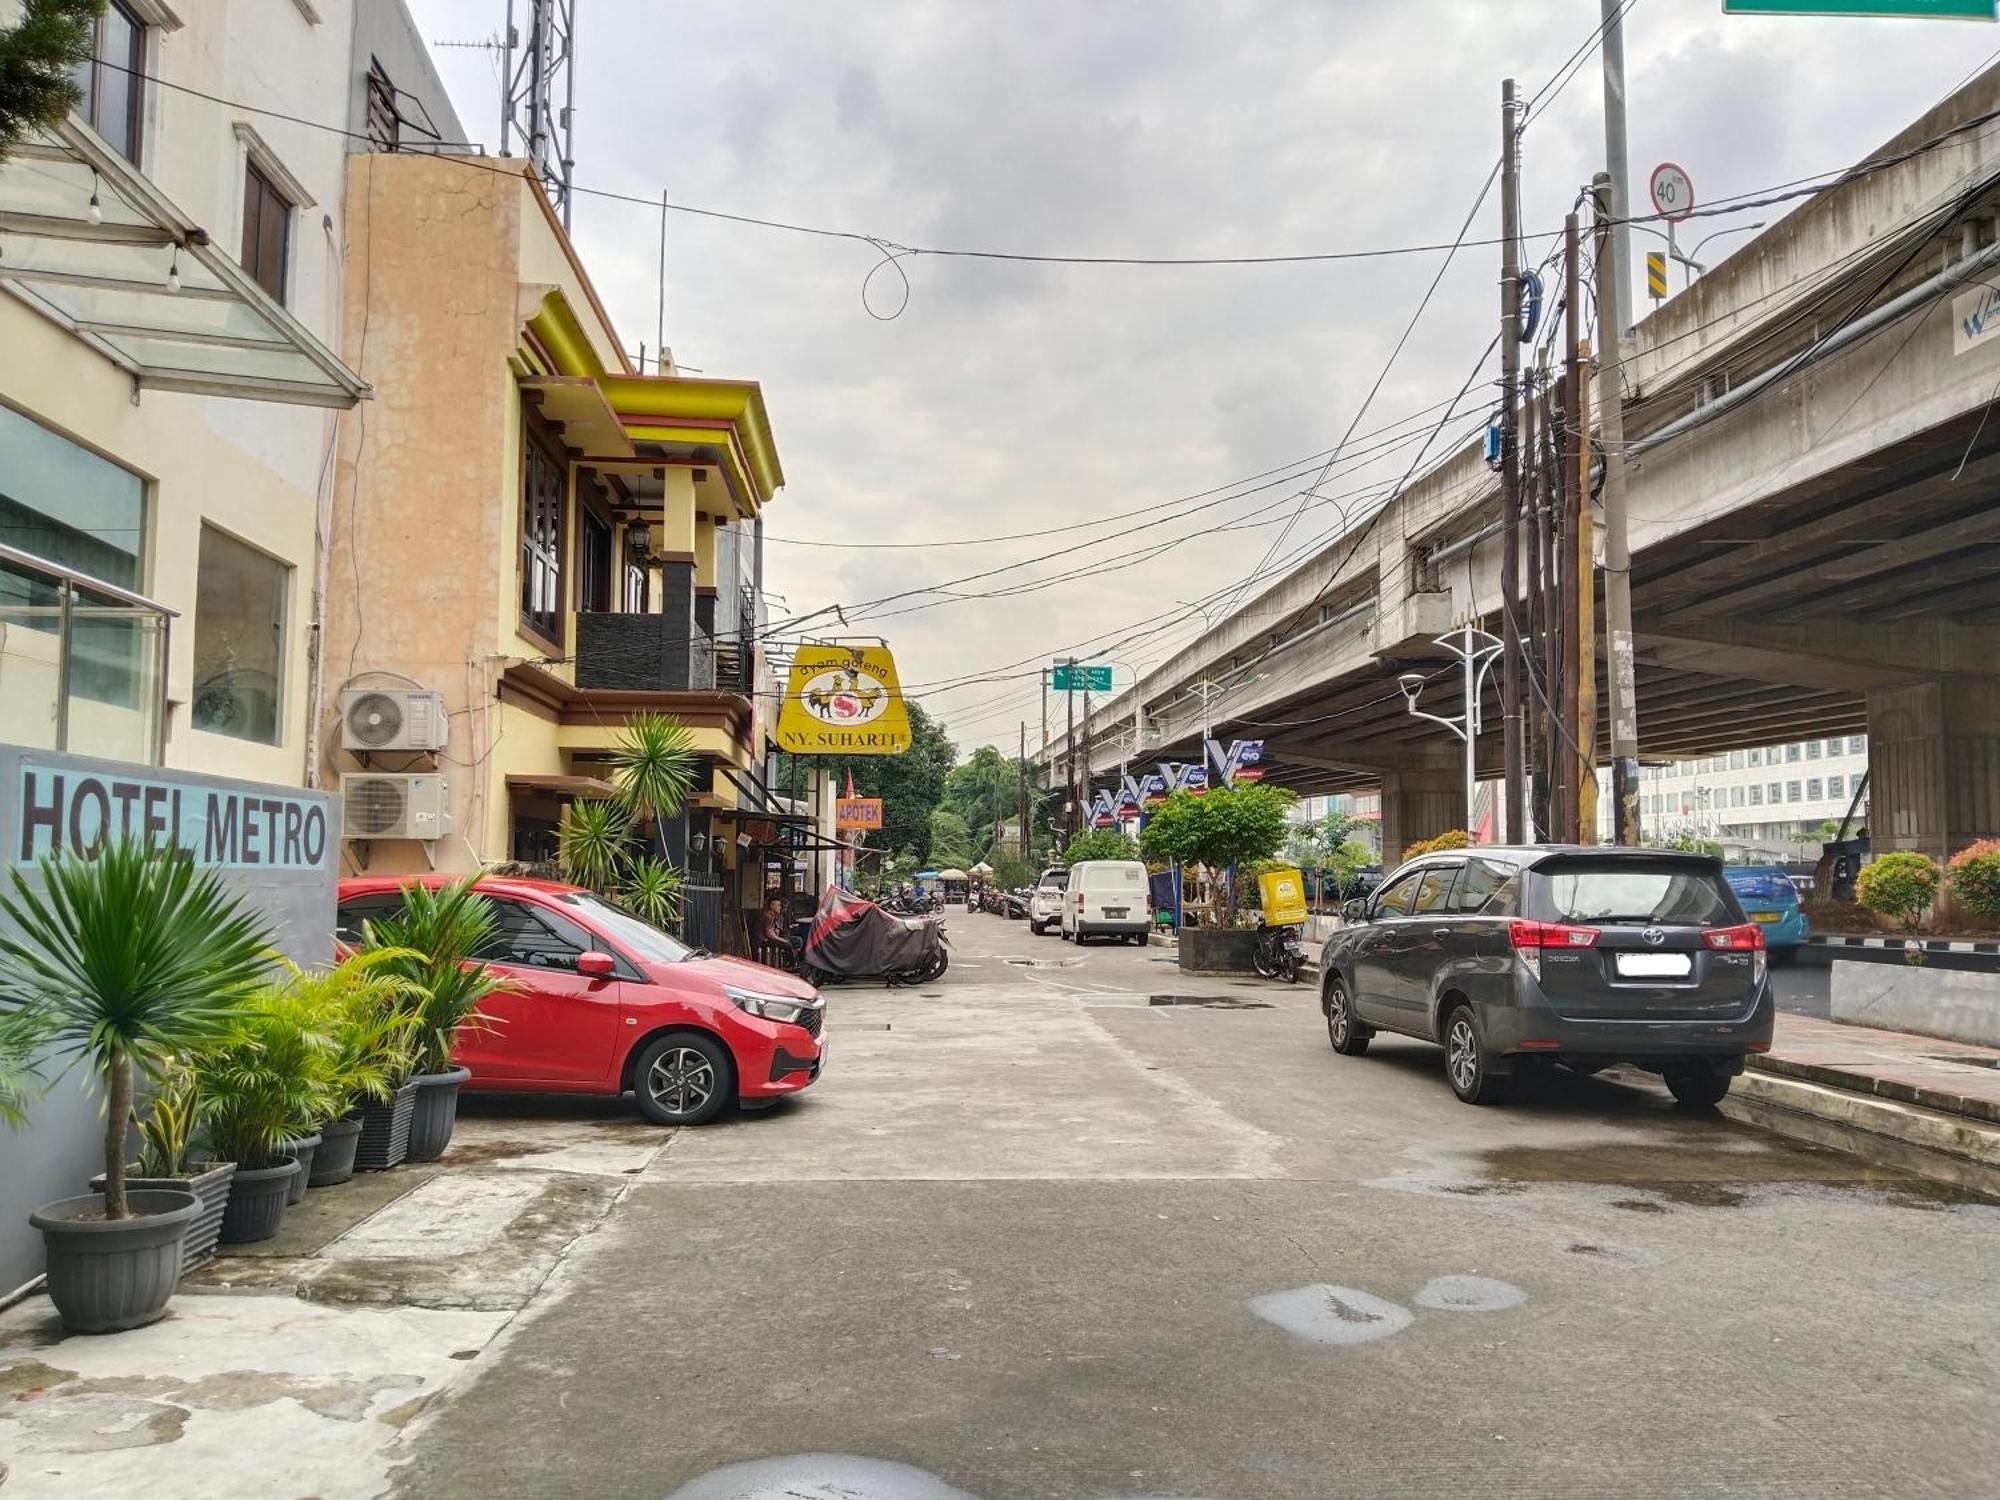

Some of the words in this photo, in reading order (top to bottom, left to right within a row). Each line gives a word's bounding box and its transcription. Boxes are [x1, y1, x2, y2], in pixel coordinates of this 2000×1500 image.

[1657, 181, 1675, 203] 40
[800, 659, 837, 677] ayam
[842, 658, 888, 679] goreng
[784, 732, 812, 746] NY.
[817, 732, 896, 746] SUHARTI
[20, 771, 193, 863] HOTEL
[204, 792, 326, 866] METRO
[840, 803, 880, 821] APOTEK
